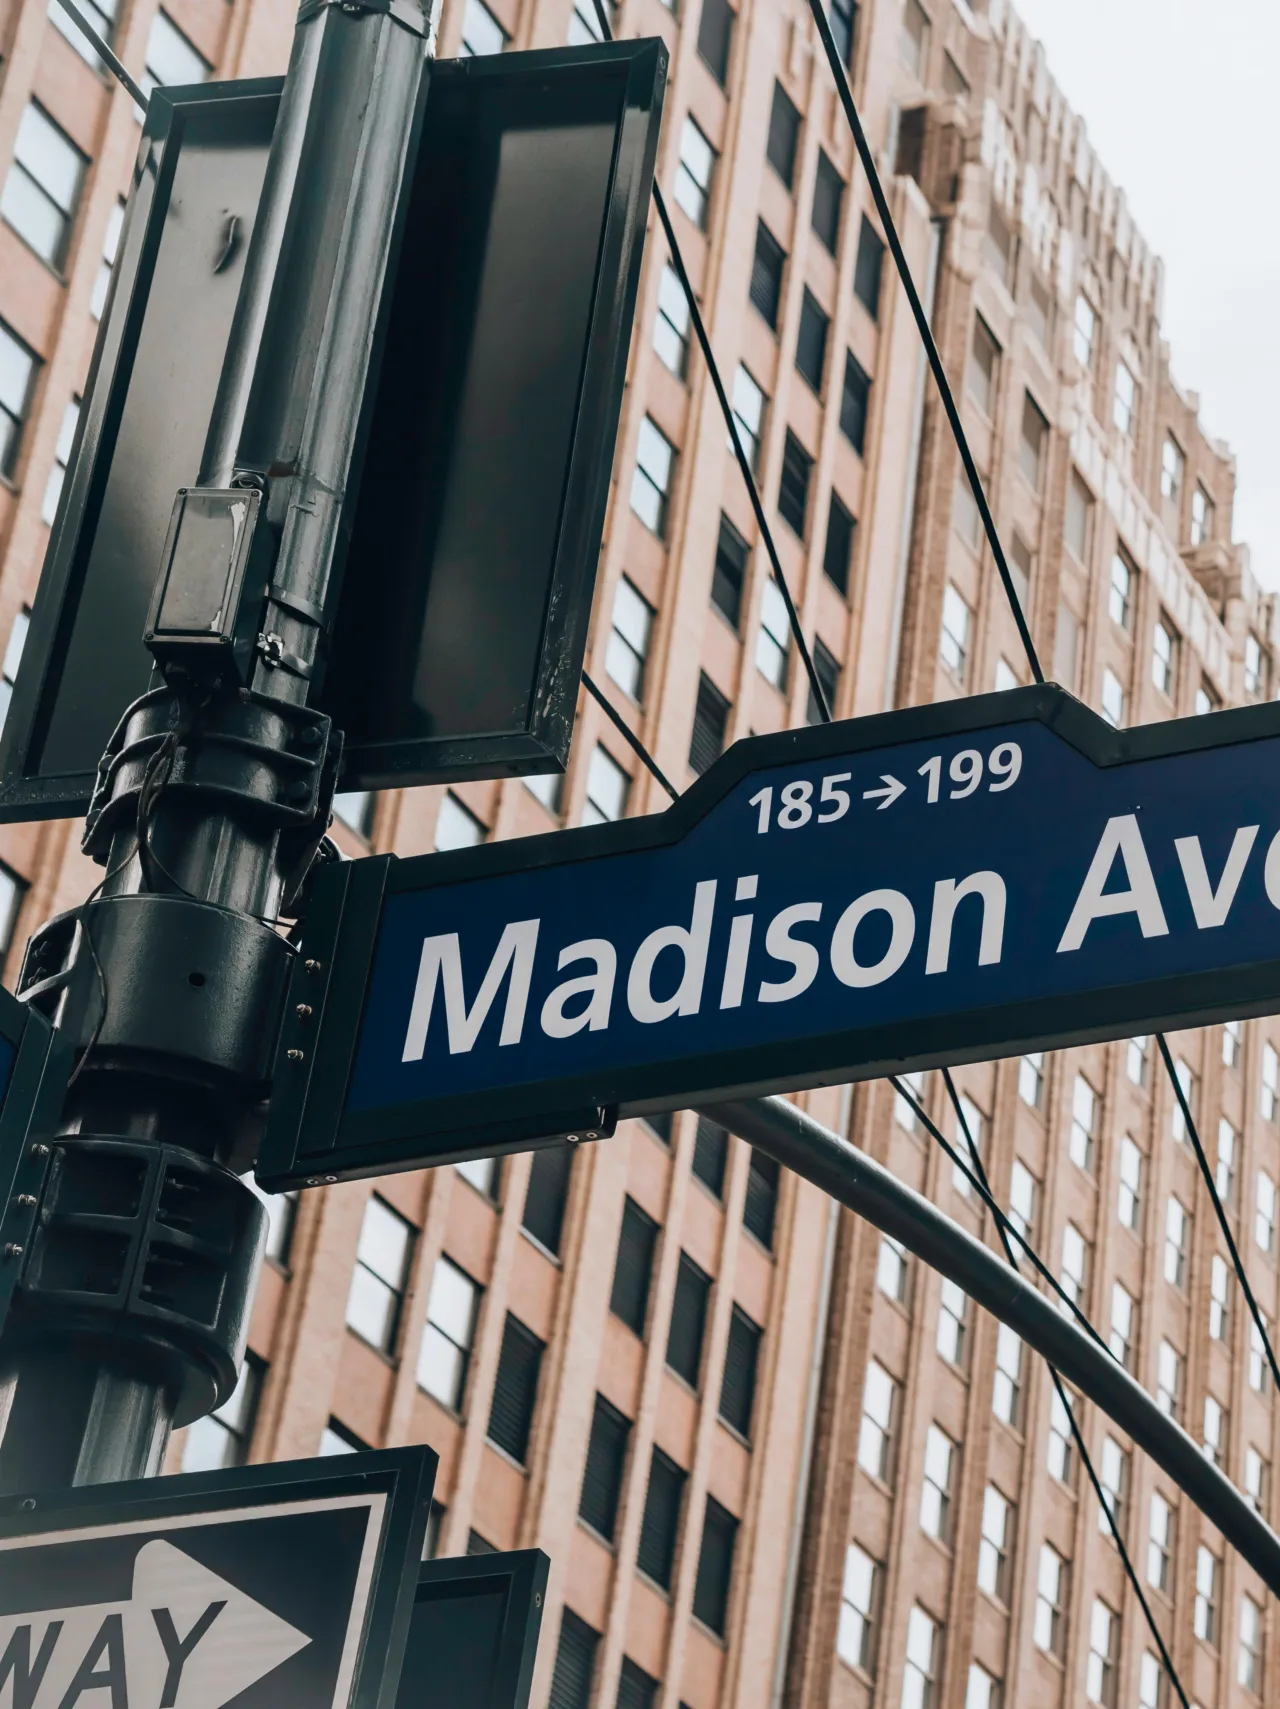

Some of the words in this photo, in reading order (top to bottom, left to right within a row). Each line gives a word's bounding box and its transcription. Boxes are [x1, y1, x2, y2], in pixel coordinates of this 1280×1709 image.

[748, 772, 852, 834] 185
[917, 742, 1023, 804] 199
[401, 870, 1007, 1063] Madison
[0, 1600, 229, 1709] WAY
